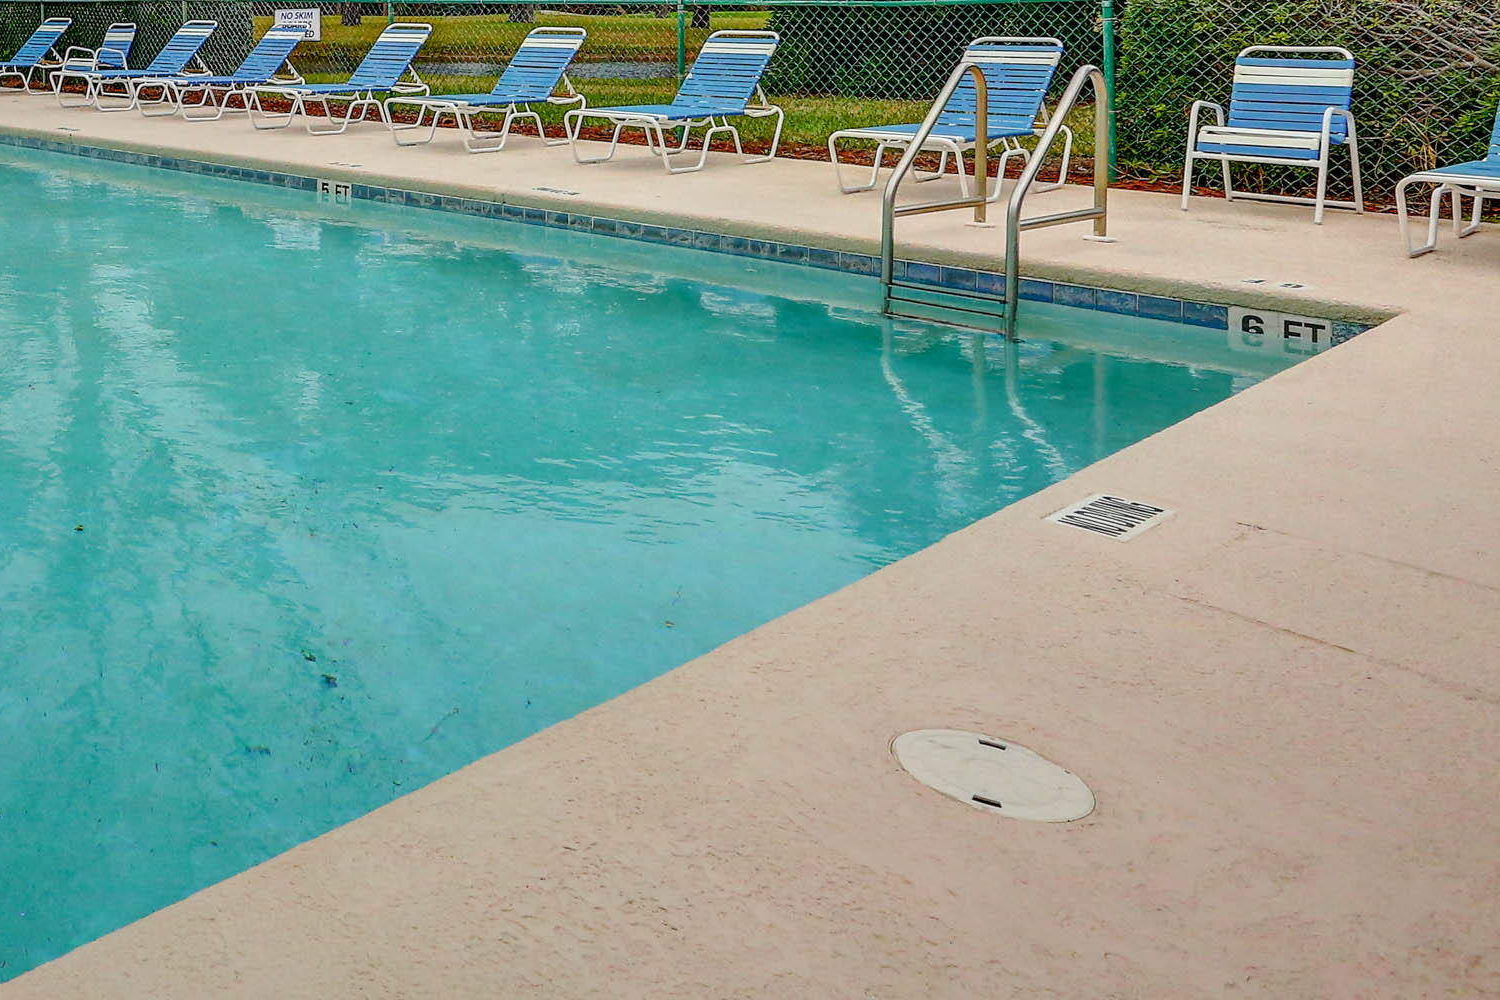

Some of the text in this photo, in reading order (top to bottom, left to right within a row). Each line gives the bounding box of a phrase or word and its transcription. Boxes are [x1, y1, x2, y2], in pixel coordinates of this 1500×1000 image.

[281, 11, 313, 20] NO SKIM
[321, 182, 350, 197] 5 FT
[1241, 314, 1326, 343] 6 FT
